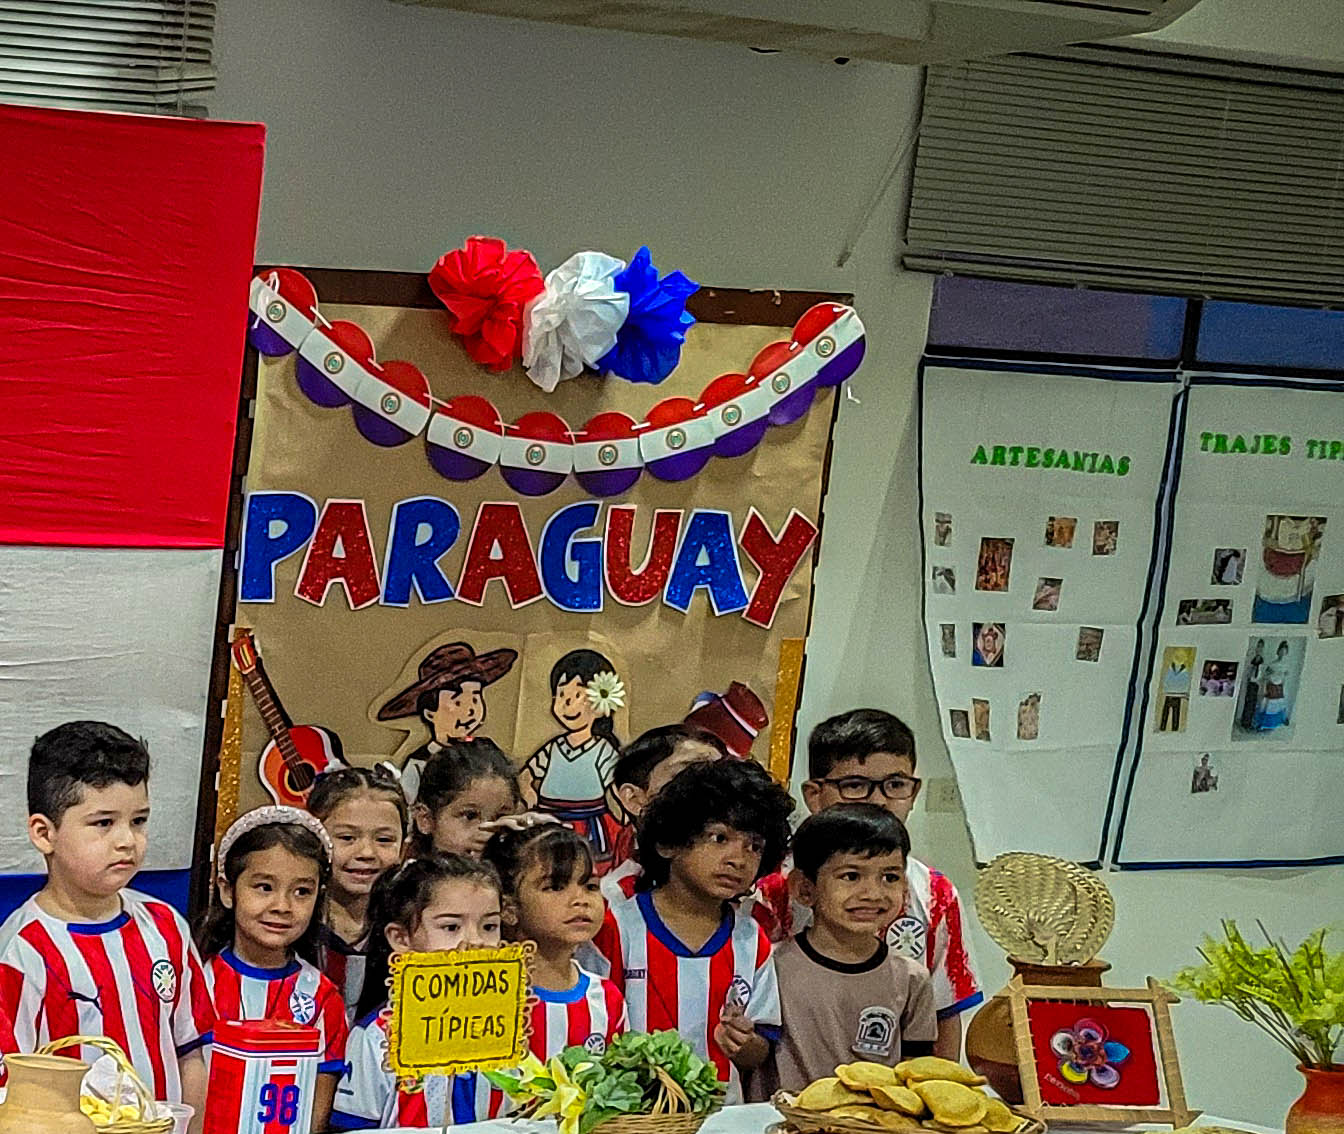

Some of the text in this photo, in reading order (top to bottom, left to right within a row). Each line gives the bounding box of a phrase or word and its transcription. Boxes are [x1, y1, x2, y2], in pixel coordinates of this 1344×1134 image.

[969, 445, 1132, 477] ARTESANIAS
[1200, 432, 1344, 461] TRAJES TIP
[238, 490, 819, 630] PARAGUAY
[412, 964, 510, 1002] COMIDAS
[257, 1083, 300, 1126] 98
